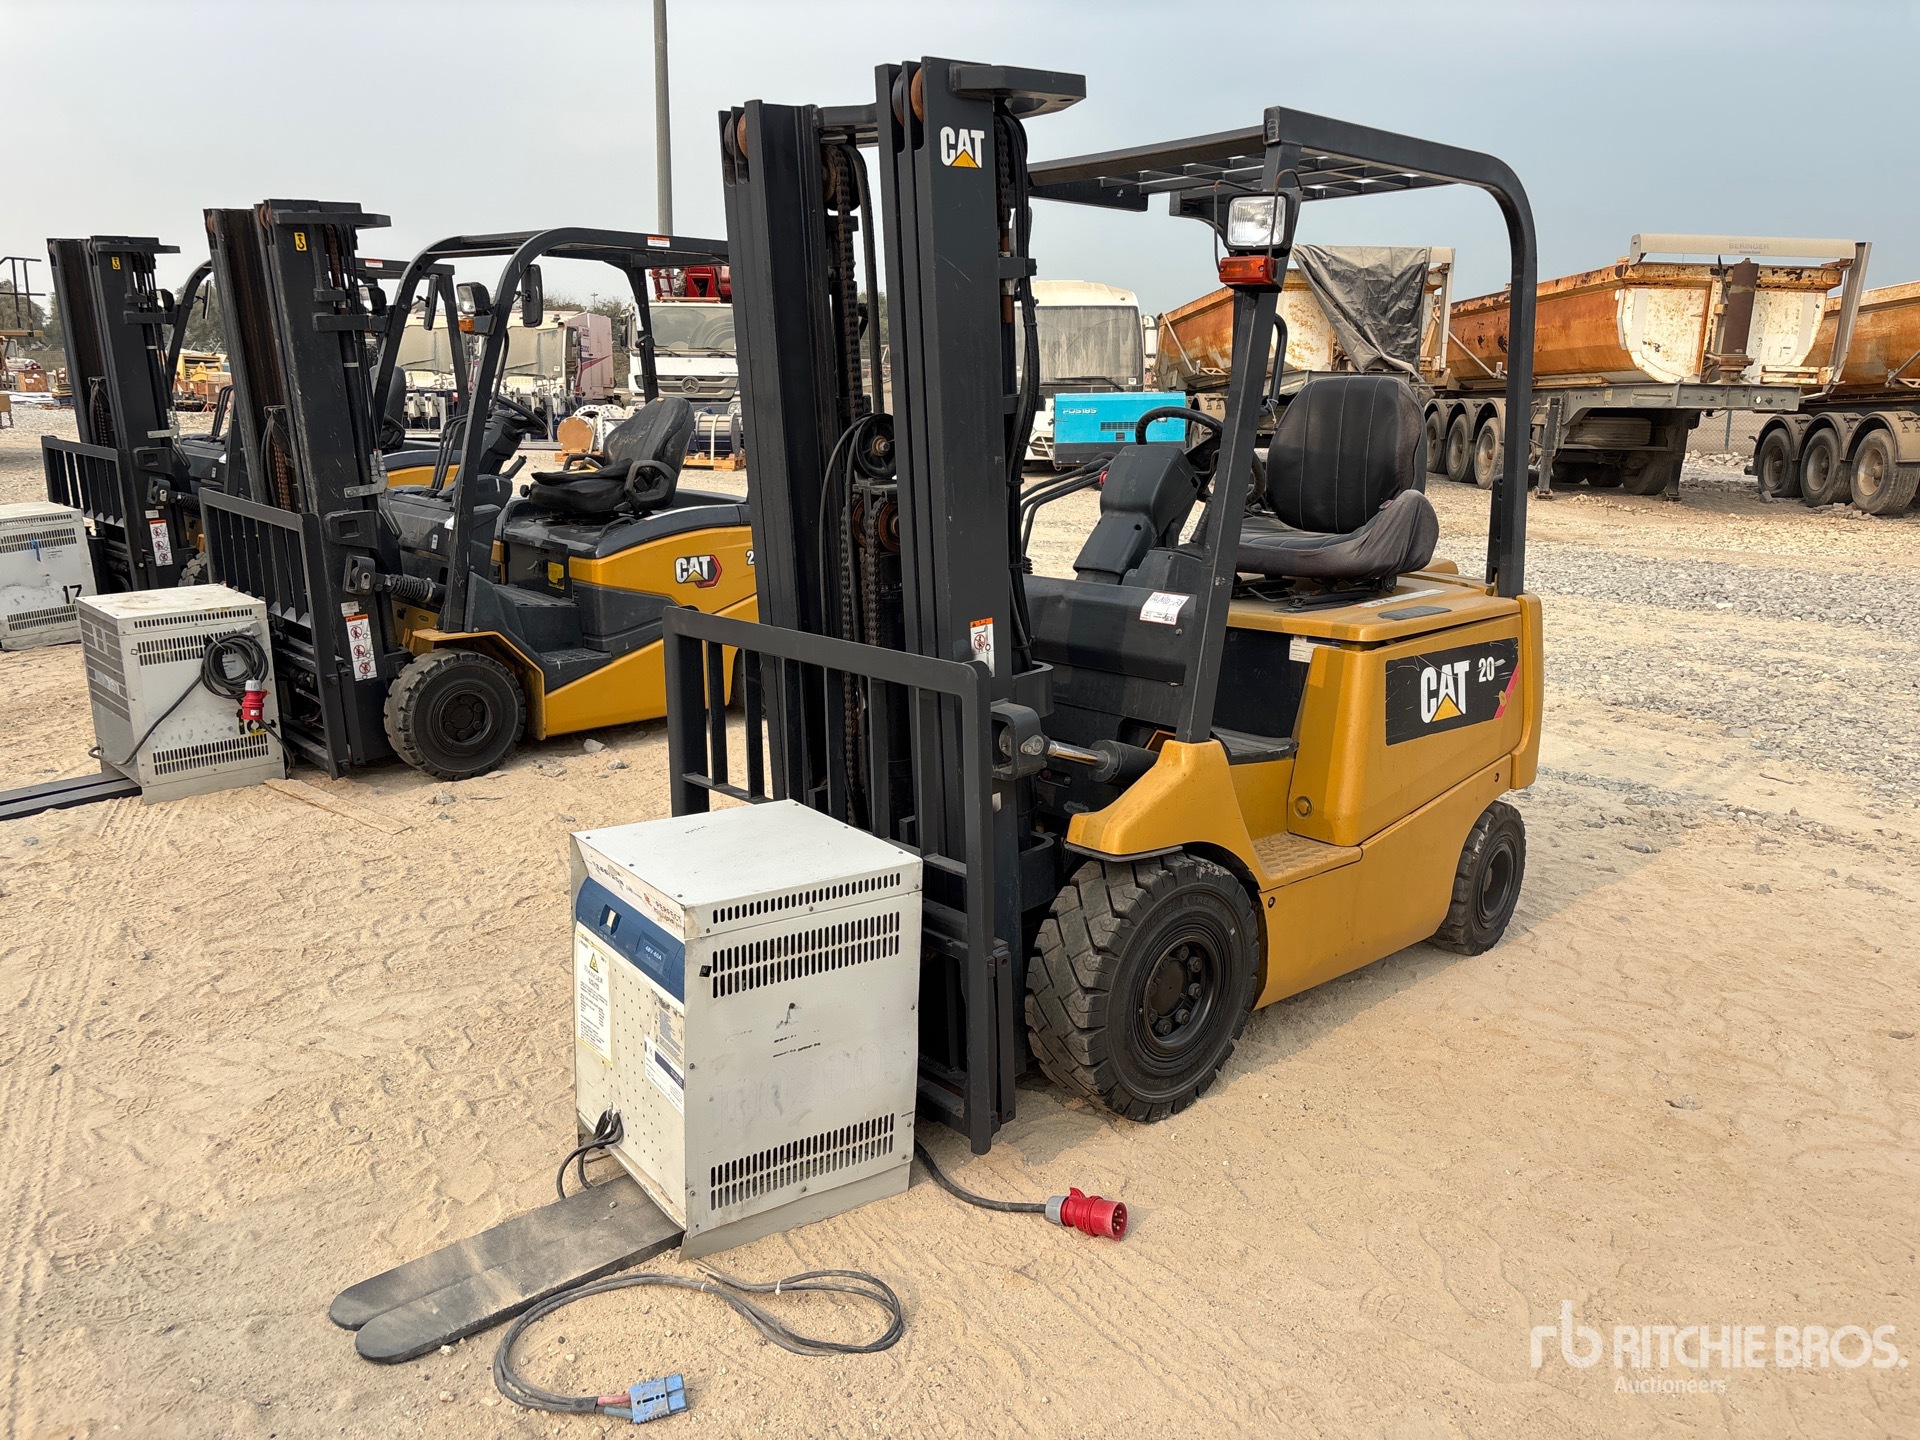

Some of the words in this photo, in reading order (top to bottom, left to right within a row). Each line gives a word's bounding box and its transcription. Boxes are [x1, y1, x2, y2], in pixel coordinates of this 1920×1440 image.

[940, 126, 985, 169] CAT
[1728, 242, 1770, 250] BERINGER
[675, 555, 711, 583] CAT
[62, 584, 83, 605] 17
[1478, 656, 1496, 683] 20
[1420, 660, 1471, 724] CAT
